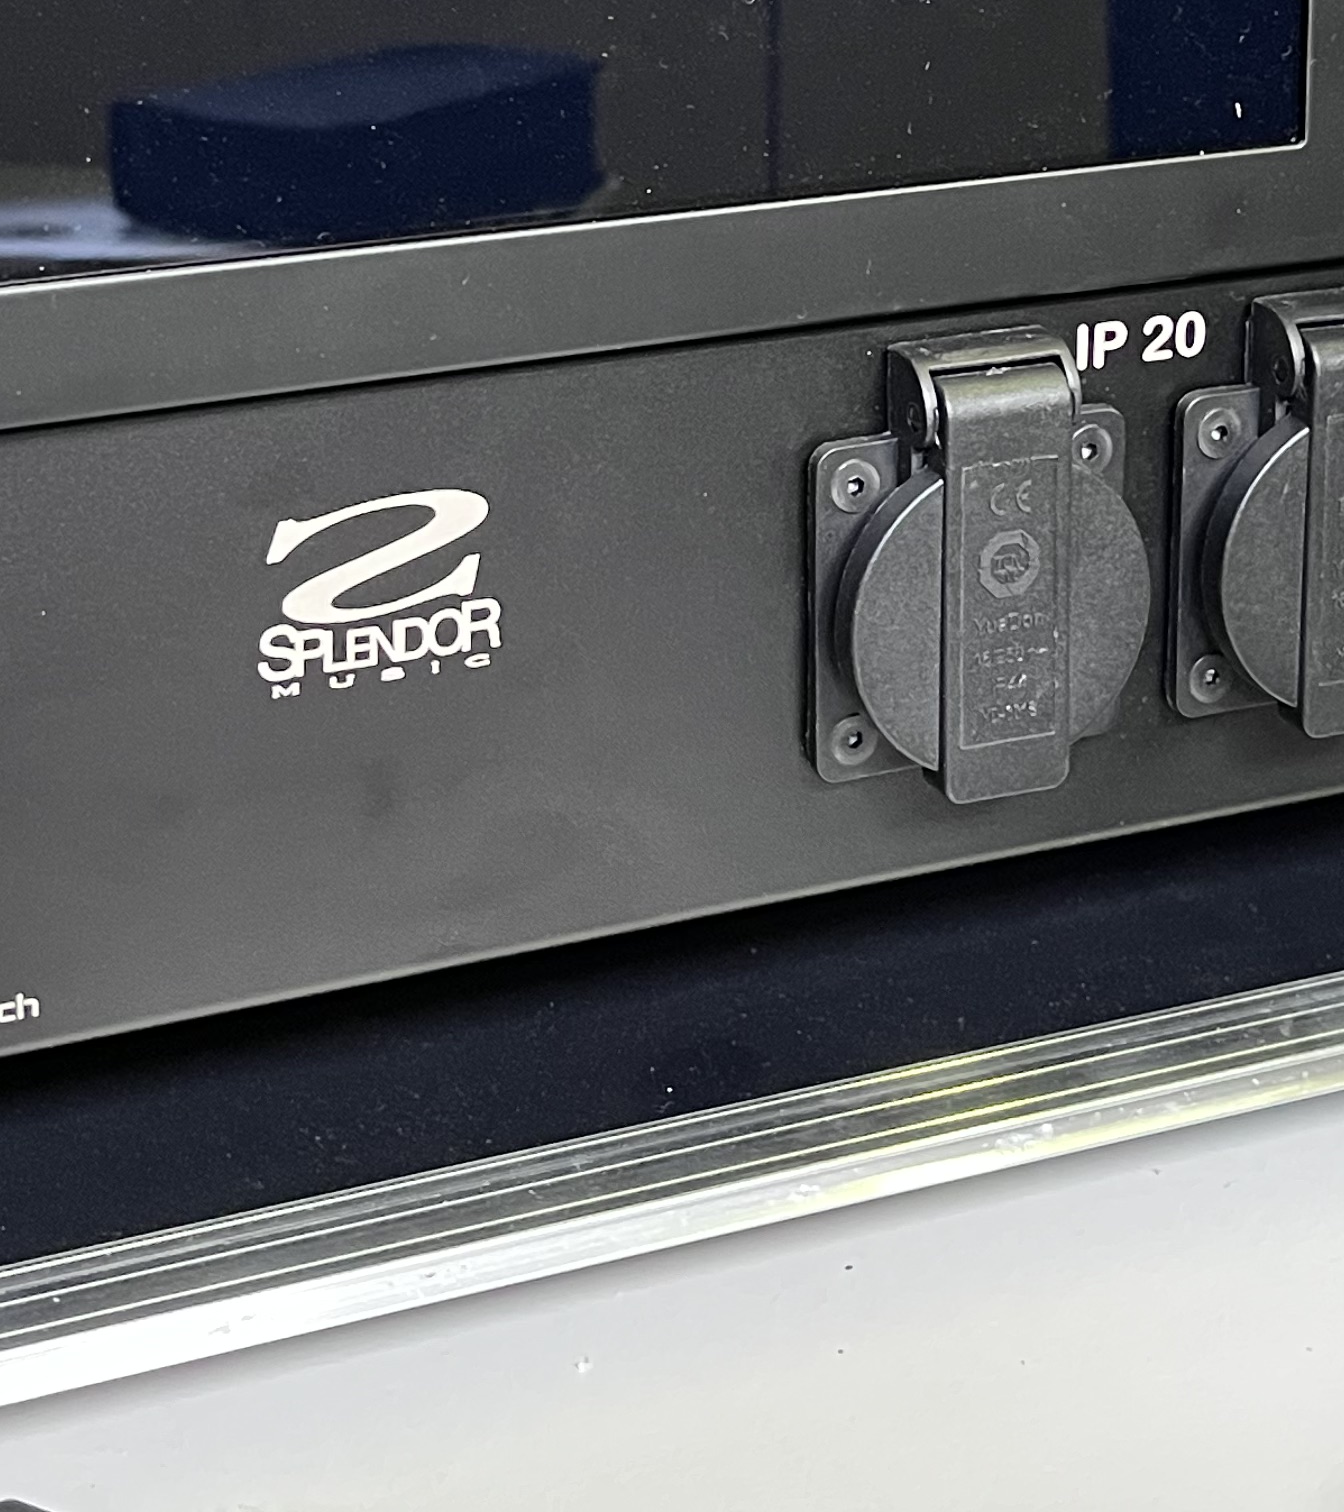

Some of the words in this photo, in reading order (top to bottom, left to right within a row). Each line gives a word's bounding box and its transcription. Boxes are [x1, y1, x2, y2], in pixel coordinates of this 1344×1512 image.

[1076, 320, 1129, 371] IP
[1141, 310, 1206, 362] 20
[257, 596, 503, 682] SPLENDOR
